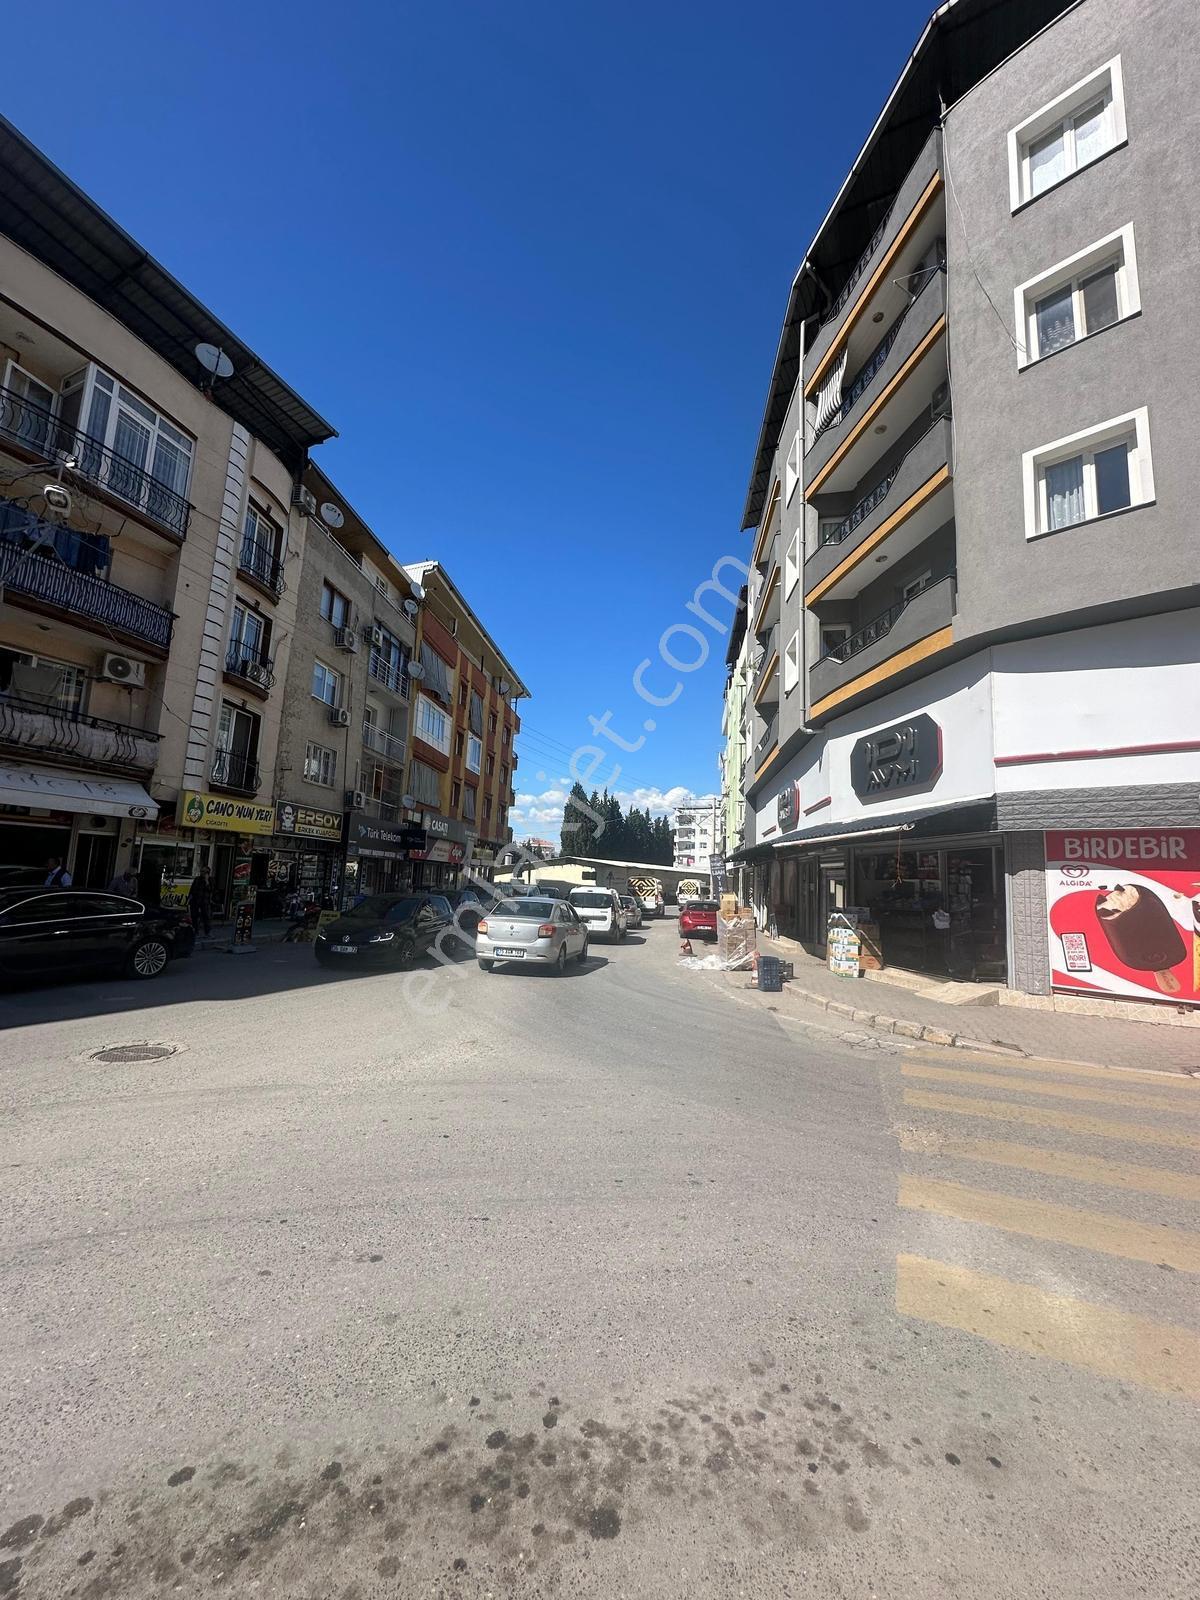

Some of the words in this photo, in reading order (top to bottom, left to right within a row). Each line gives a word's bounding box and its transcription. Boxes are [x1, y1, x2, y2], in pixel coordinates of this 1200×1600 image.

[297, 809, 341, 828] ERSOY
[366, 827, 380, 839] Türk
[380, 829, 401, 843] Telekom
